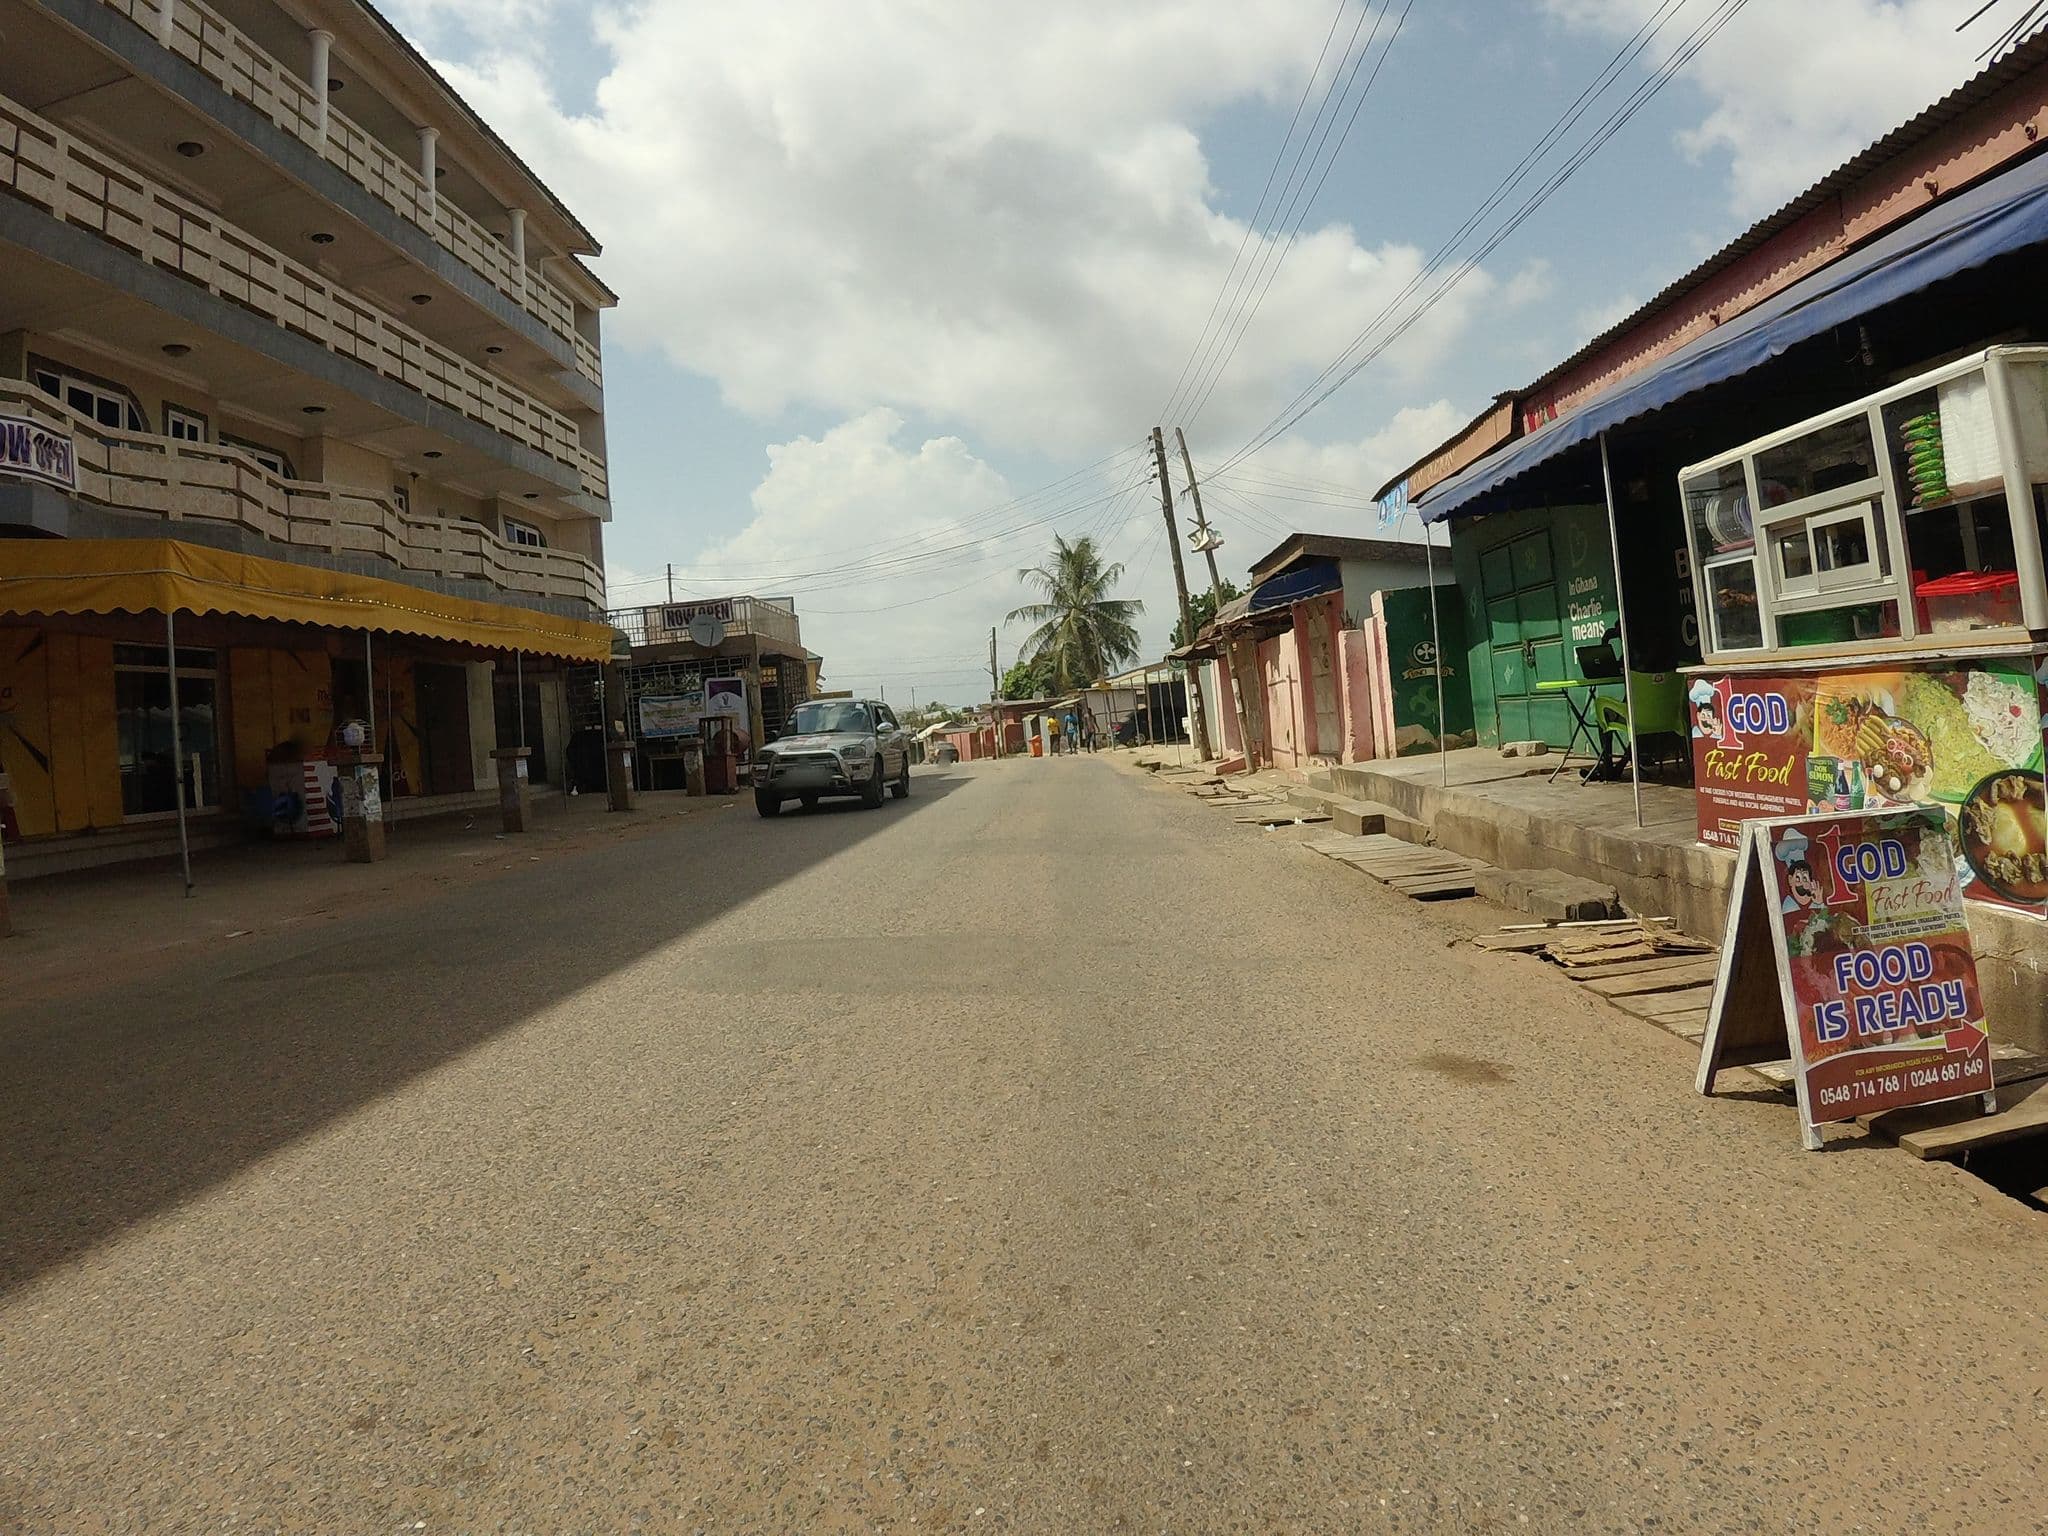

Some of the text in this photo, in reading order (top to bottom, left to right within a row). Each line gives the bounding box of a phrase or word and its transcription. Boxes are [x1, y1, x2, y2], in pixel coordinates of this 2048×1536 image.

[1575, 576, 1598, 593] Ghana
[666, 608, 695, 627] NOW
[1572, 620, 1605, 641] means
[1727, 693, 1789, 734] GOD
[1705, 749, 1795, 786] Fast Food
[1703, 829, 1719, 841] 0548
[1719, 832, 1732, 844] 714
[1835, 839, 1906, 884] GOD
[1871, 874, 1956, 914] Fast Food
[1834, 942, 1933, 994] FOOD
[1813, 979, 1968, 1043] IS READY
[1820, 1085, 1850, 1106] 0548
[1853, 1080, 1875, 1099] 714
[1878, 1075, 1900, 1094] 768
[1910, 1068, 1939, 1087] 0244
[1941, 1063, 1960, 1082] 687
[1964, 1058, 1984, 1077] 649
